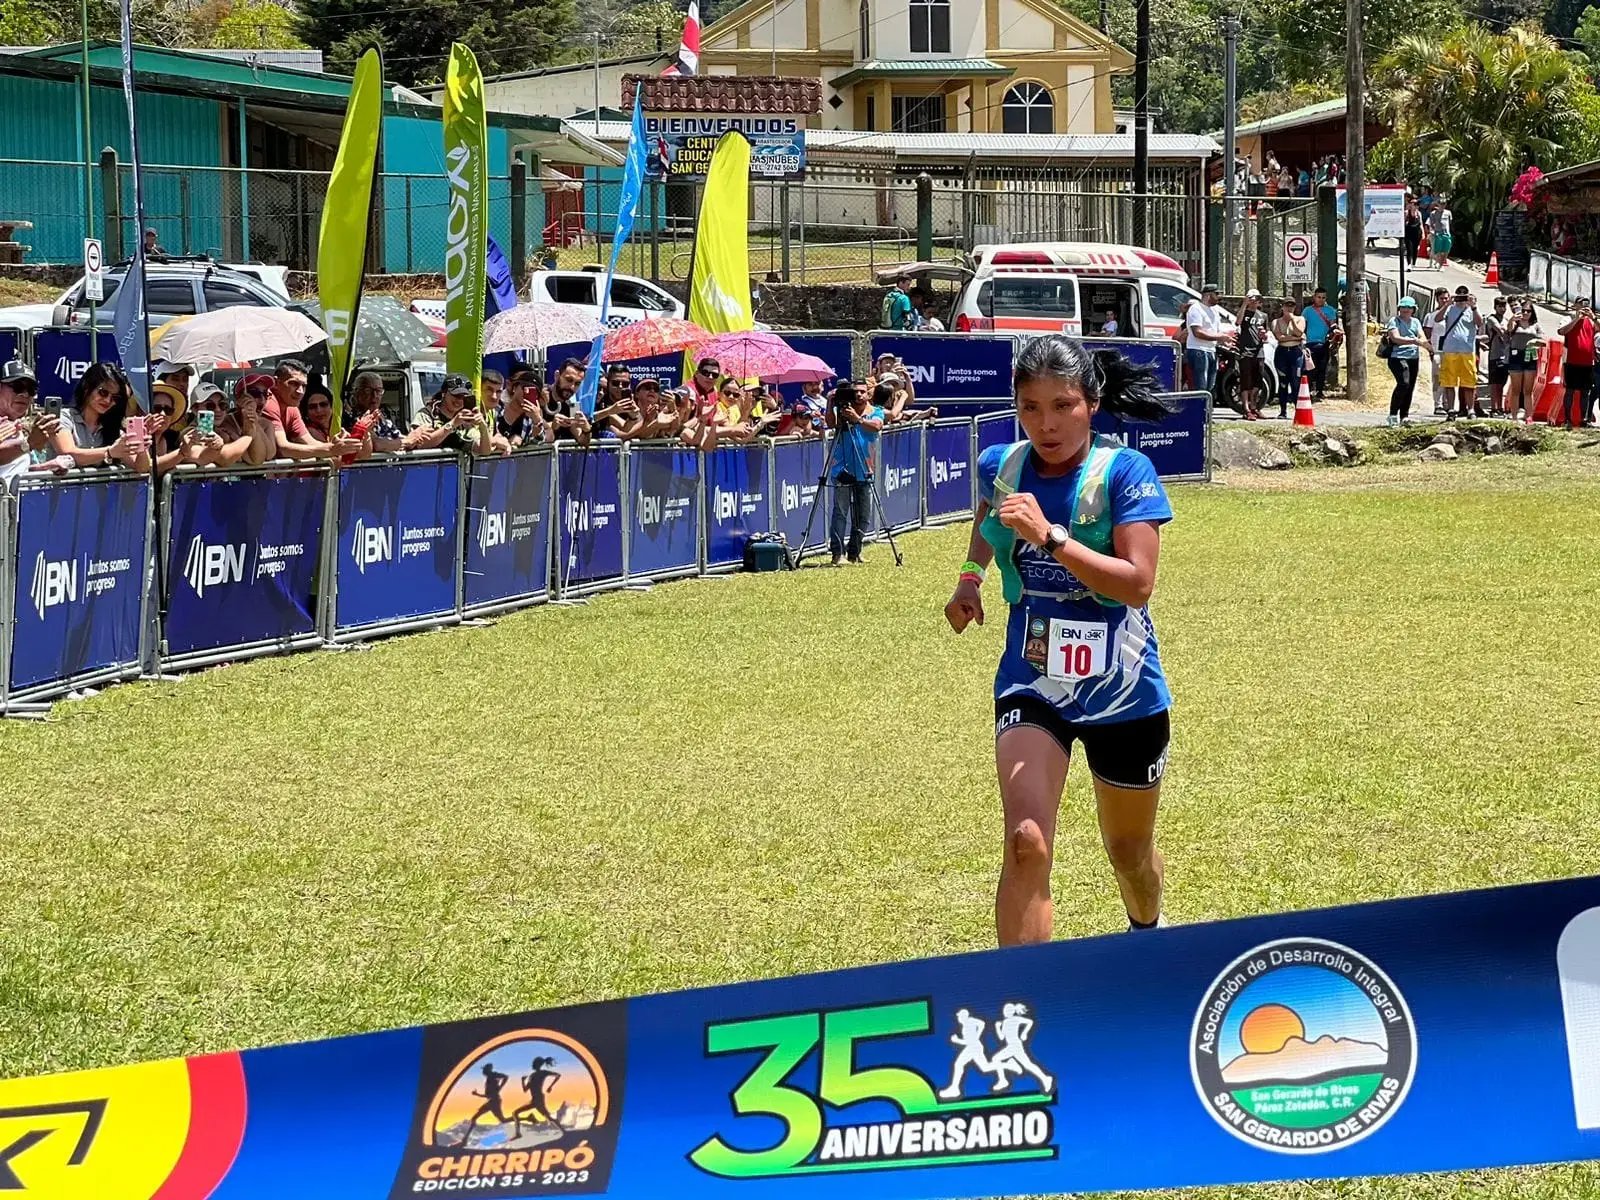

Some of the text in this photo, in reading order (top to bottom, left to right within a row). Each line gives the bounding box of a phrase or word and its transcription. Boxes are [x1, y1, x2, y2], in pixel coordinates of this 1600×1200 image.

[646, 118, 797, 135] BIENVENIDOS
[671, 163, 693, 174] SAN
[768, 156, 799, 164] NUBES
[465, 214, 479, 318] ANTIOXIDANTES
[947, 374, 981, 384] progreso
[1140, 430, 1190, 440] Juntos somos
[1140, 438, 1174, 448] progreso
[889, 468, 899, 491] BN
[937, 461, 948, 483] BN
[721, 491, 738, 519] BN
[787, 484, 798, 511] BN
[644, 496, 660, 524] BN
[402, 527, 424, 540] Juntos
[486, 512, 506, 547] BN
[365, 526, 393, 564] BN
[402, 542, 431, 558] progreso
[88, 558, 130, 576] Juntos somos
[205, 543, 247, 586] BN
[45, 559, 77, 607] BN
[86, 577, 116, 597] progreso
[1061, 628, 1082, 640] BN
[1086, 631, 1102, 639] 34K
[1059, 643, 1092, 676] 10
[1198, 949, 1402, 1055] Asociación de Desarrollo Integral
[690, 1000, 930, 1177] 35
[1213, 1077, 1400, 1146] SAN GERARDO DE RIVAS
[1331, 1096, 1355, 1108] C.R.
[819, 1110, 1049, 1160] ANIVERSARIO
[418, 1139, 595, 1180] CHIRRIPÓ
[412, 1174, 497, 1192] EDICIÓN
[499, 1174, 524, 1188] 35
[541, 1170, 589, 1185] 2023
